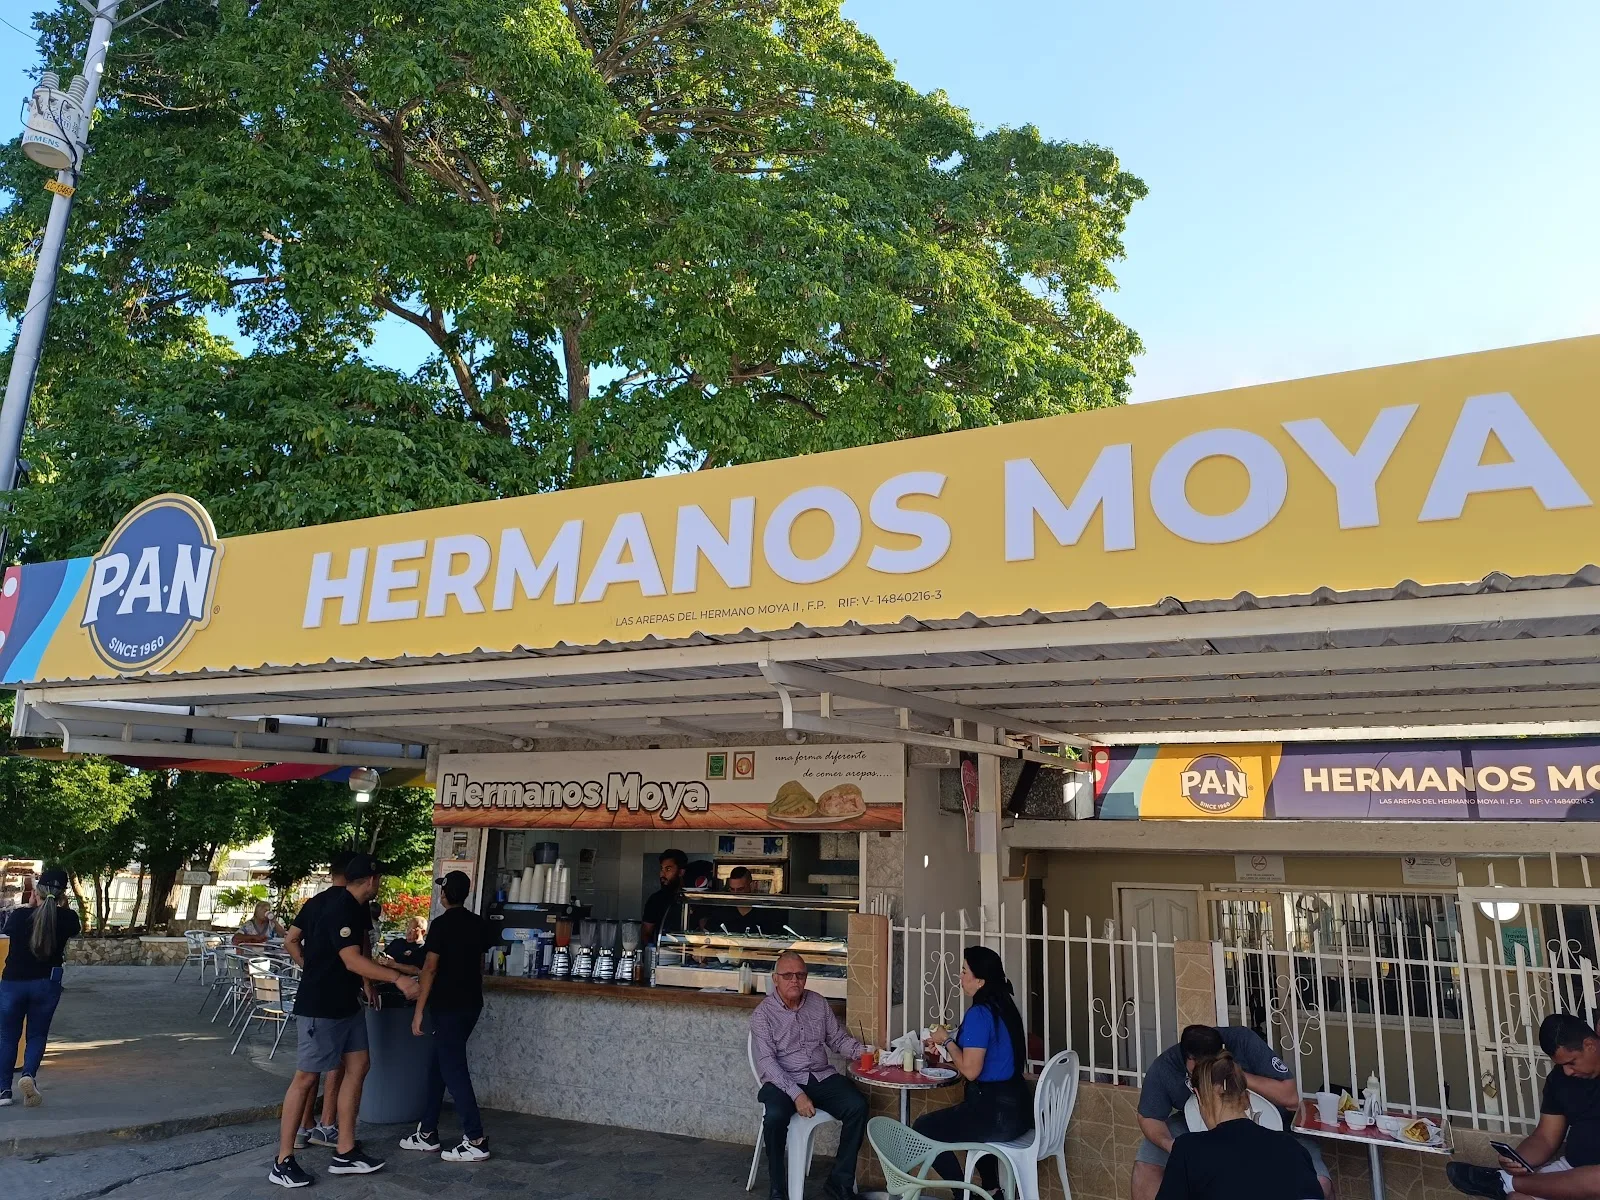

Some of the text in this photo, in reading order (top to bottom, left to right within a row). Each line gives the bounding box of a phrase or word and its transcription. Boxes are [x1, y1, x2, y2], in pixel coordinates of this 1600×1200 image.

[24, 135, 60, 148] SIEMENS
[302, 391, 1593, 629] HERMANOS MOYA
[615, 617, 633, 627] LAS
[636, 613, 675, 625] AREPAS
[677, 611, 697, 621] DEL
[700, 606, 755, 620] HERMANO
[758, 602, 790, 615] MOYA
[807, 600, 826, 611] F.P.
[838, 597, 859, 608] RIF:
[862, 597, 874, 606] V-
[877, 589, 942, 604] 14840216-3
[109, 635, 164, 657] SINCE 1960
[794, 752, 822, 766] forma
[825, 750, 867, 765] diferente
[803, 768, 814, 778] de
[1303, 766, 1536, 792] HERMANOS
[442, 772, 710, 822] Hermanos Moya
[1200, 801, 1217, 809] SINCE
